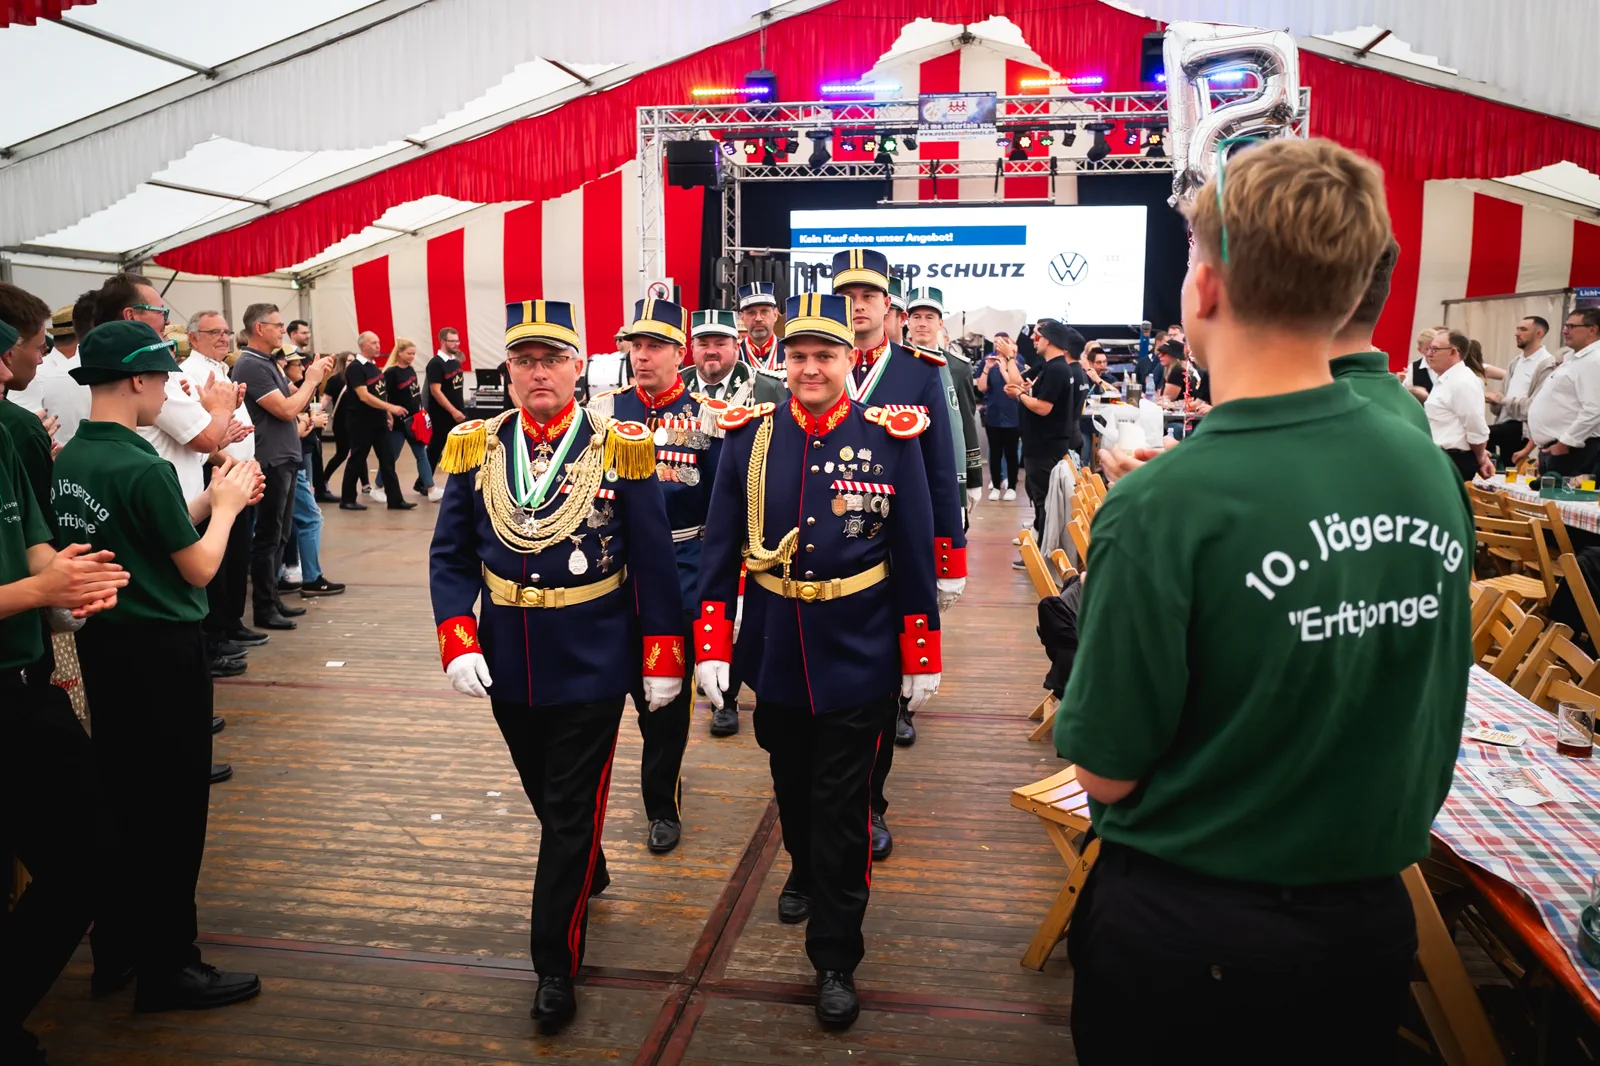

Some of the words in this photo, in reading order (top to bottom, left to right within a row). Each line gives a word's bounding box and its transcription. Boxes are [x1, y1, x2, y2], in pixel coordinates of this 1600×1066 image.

[799, 234, 822, 244] Kein
[823, 233, 848, 243] Kauf
[848, 233, 875, 243] ohne
[876, 234, 905, 243] unser
[905, 232, 954, 244] Angebot!
[926, 262, 1026, 278] SCHULTZ
[58, 478, 110, 521] Jägerzug
[1245, 550, 1310, 601] 10.
[1308, 512, 1464, 573] Jägerzug
